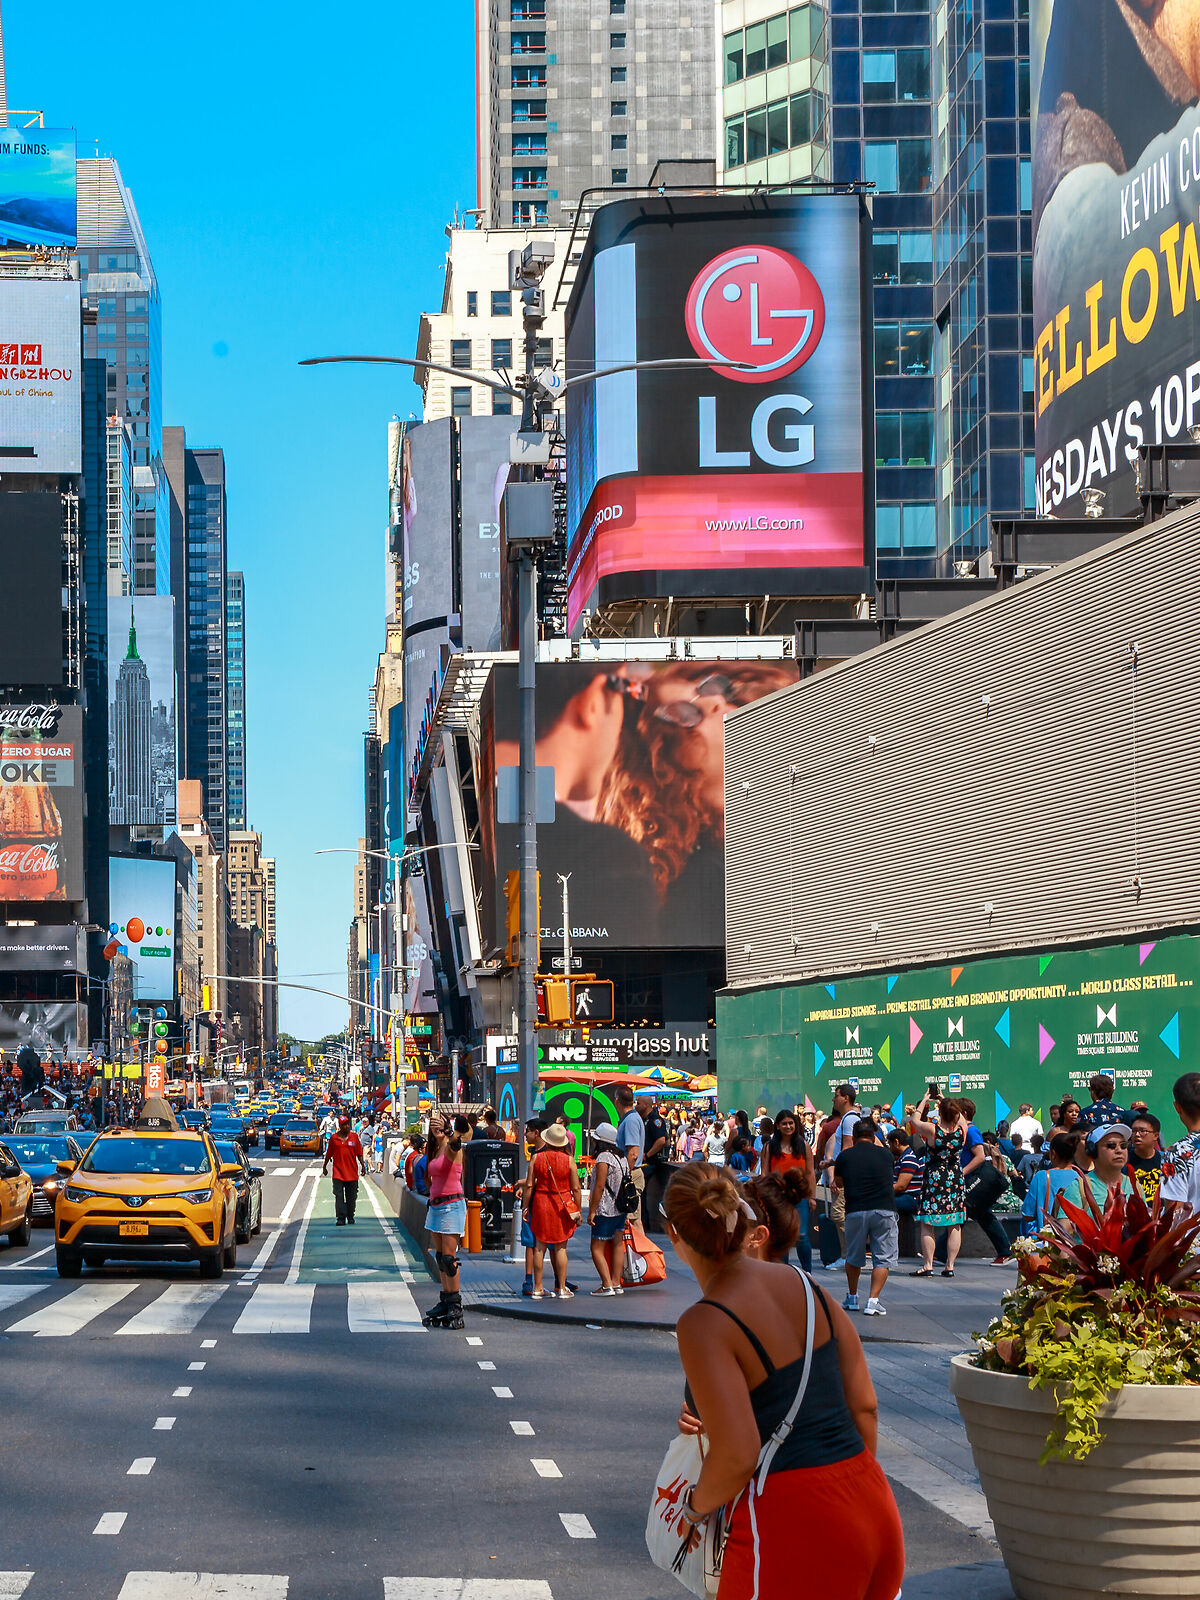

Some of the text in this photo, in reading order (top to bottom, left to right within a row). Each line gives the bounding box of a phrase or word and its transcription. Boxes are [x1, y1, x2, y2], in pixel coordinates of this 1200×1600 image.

[14, 143, 50, 155] FUNDS:
[1121, 151, 1171, 240] KEVIN
[1034, 205, 1200, 432] ELLOW
[15, 387, 25, 397] of
[28, 387, 53, 397] China
[1150, 358, 1200, 446] 10P
[698, 393, 815, 467] LG
[1035, 399, 1145, 520] NESDAYS
[705, 515, 804, 531] www.LG.com
[1, 746, 32, 757] ZERO
[34, 746, 72, 757] SUGAR
[20, 873, 47, 881] SUGAR
[810, 974, 1178, 1021] UNPARALLELED SIGNAGE PRIME RETAIL SPACE AND BRANDING OPPORTUNITY WORLD CLASS RETAIL
[675, 1031, 709, 1053] hut
[1077, 1030, 1138, 1046] BOW TIE BUILDING
[548, 1046, 588, 1062] NYC
[851, 1047, 873, 1058] BUILDING
[932, 1042, 945, 1053] BOW
[954, 1040, 980, 1052] BUILDING
[147, 1064, 162, 1089] tkts
[147, 1117, 162, 1127] 8J96
[487, 1212, 494, 1227] 2
